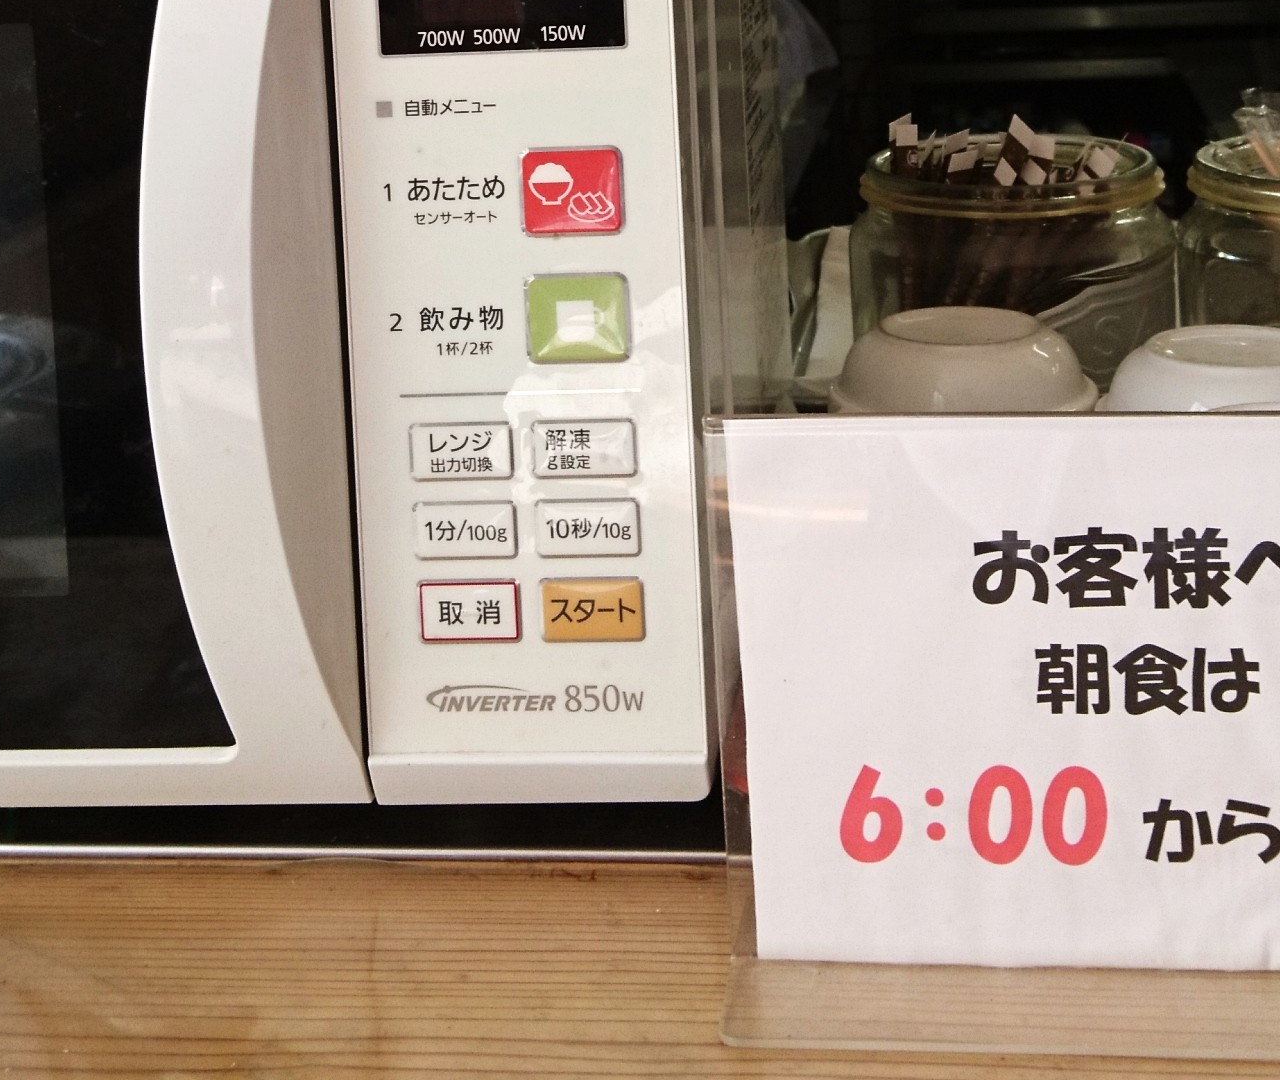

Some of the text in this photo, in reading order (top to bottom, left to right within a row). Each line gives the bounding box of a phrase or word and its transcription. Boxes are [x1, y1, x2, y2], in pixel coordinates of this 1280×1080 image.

[417, 25, 586, 47] 700W 500W 150W
[404, 99, 497, 116] 自動メニュー
[383, 175, 506, 201] 1 あたため
[413, 211, 498, 225] センサーオート
[389, 306, 504, 331] 2 飲み物
[429, 431, 492, 453] レンジ
[543, 428, 593, 452] 解凍
[430, 457, 493, 473] 出力切換
[546, 453, 593, 472] g設定
[424, 520, 508, 542] 1分/100g
[546, 519, 632, 540] 10秒/10g
[438, 600, 501, 625] 取消
[550, 598, 637, 623] スタート
[1034, 644, 1261, 715] 朝食は
[428, 685, 644, 713] INVERTER 850W
[839, 765, 1108, 866] 6:00
